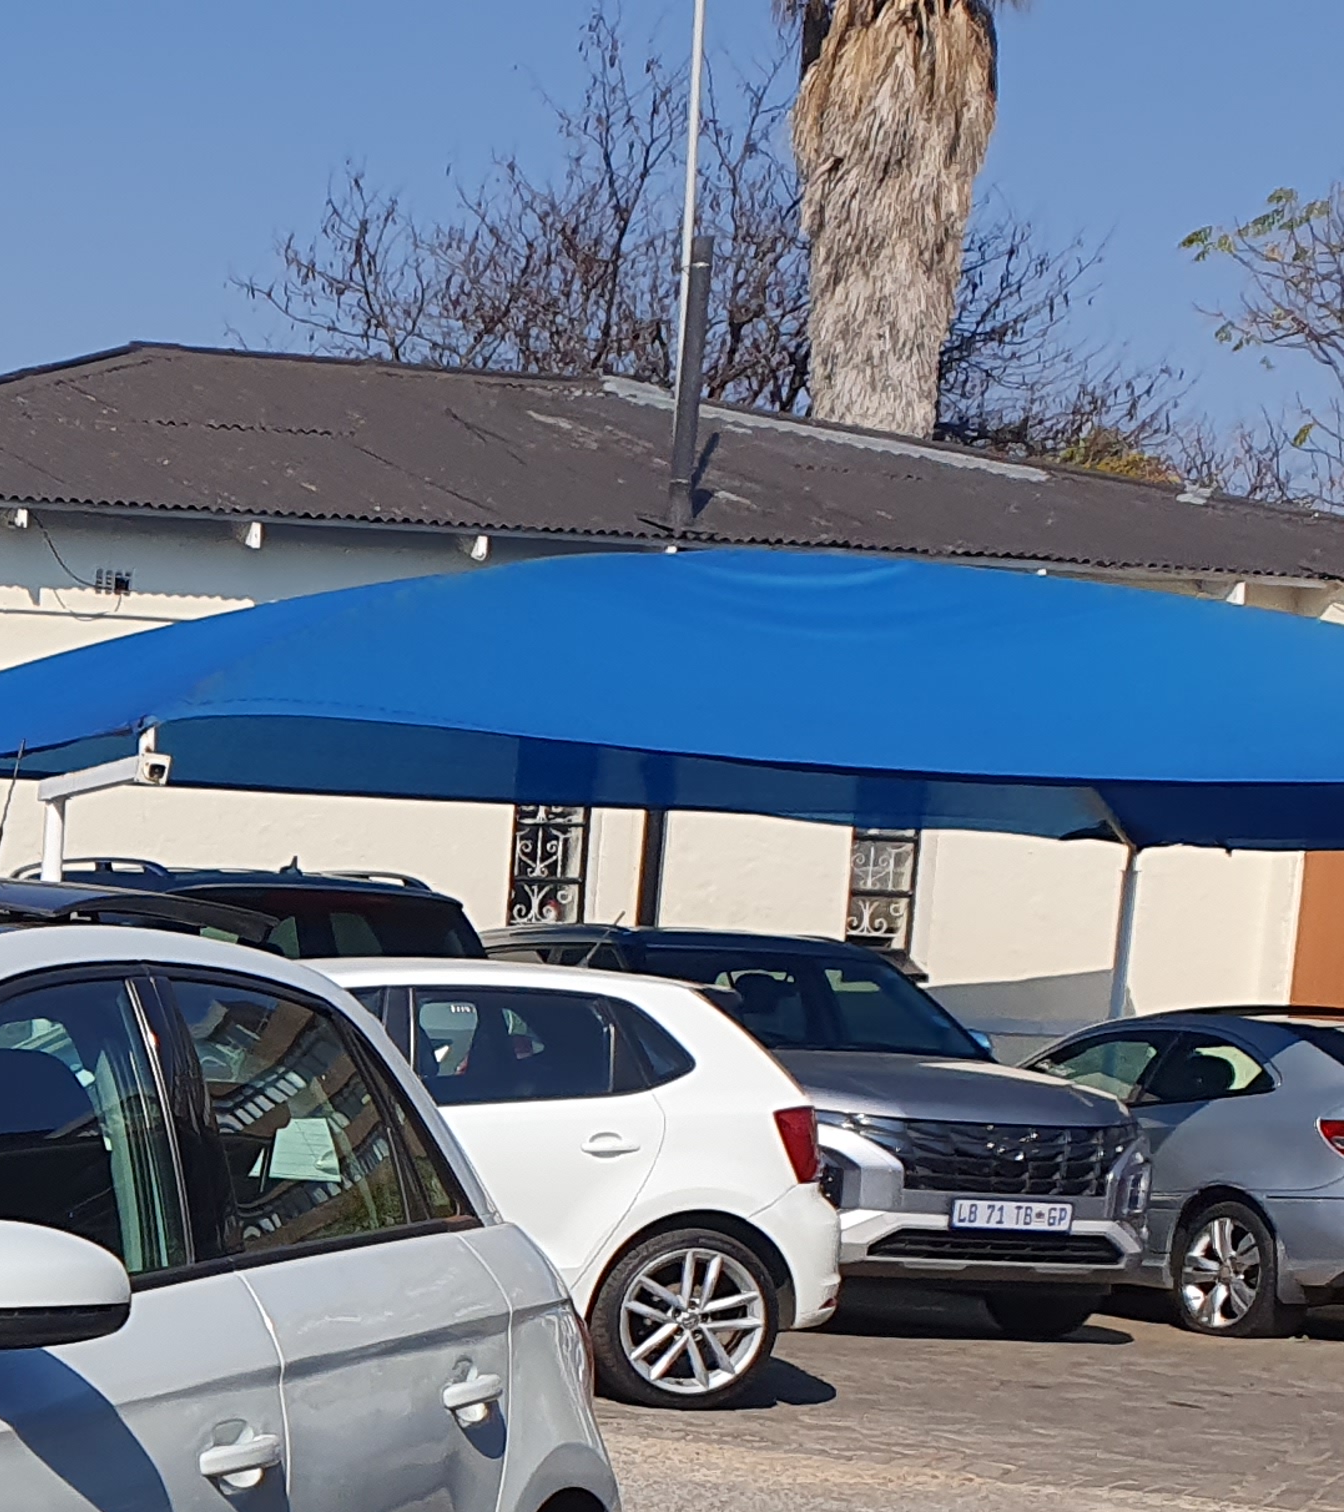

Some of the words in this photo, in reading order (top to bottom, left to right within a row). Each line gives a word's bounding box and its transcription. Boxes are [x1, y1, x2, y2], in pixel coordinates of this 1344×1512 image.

[957, 1203, 978, 1224] LB
[986, 1204, 1005, 1225] 71
[1014, 1205, 1034, 1226] TB
[1047, 1207, 1068, 1227] GP
